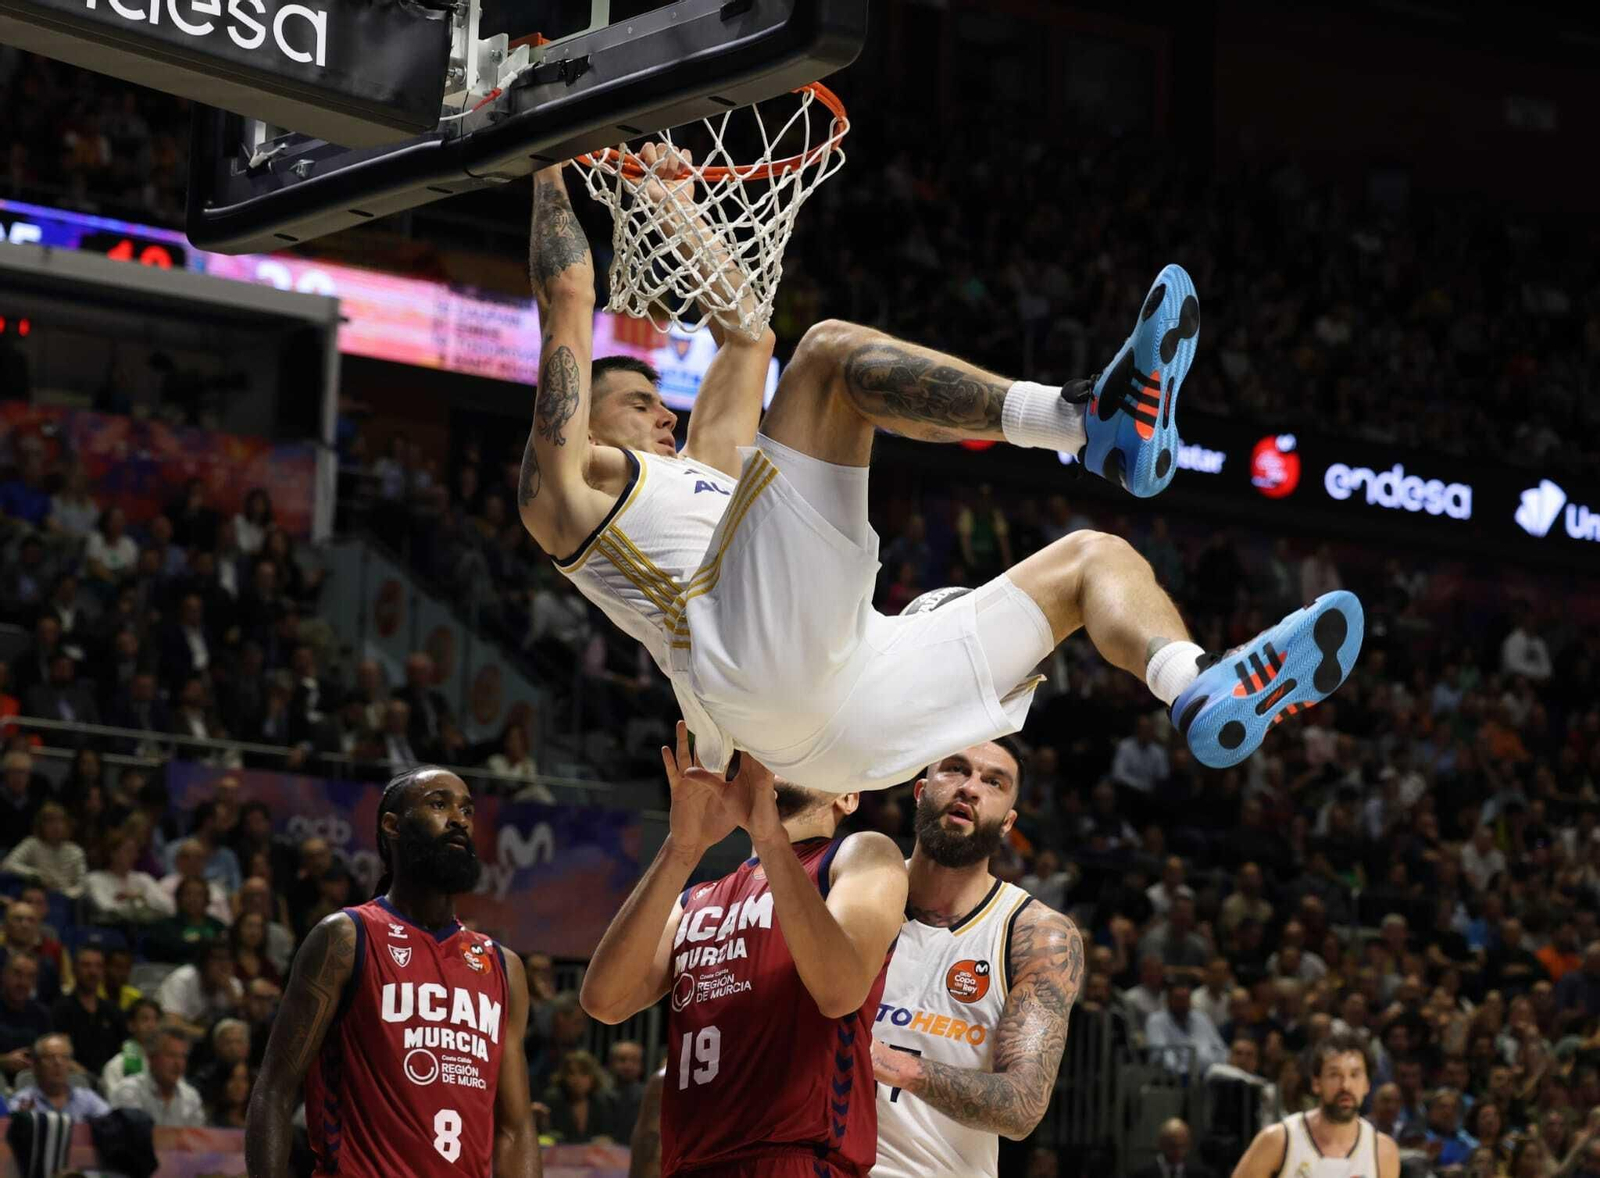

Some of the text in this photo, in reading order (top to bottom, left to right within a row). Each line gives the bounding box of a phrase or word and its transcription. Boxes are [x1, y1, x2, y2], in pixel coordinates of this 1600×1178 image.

[1324, 462, 1473, 521] endesa
[381, 982, 502, 1045] UCAM
[696, 980, 752, 1003] DE MURCIA
[404, 1027, 489, 1063] MURCIA
[679, 1025, 722, 1091] 19
[441, 1062, 479, 1077] REGIÓN
[442, 1073, 456, 1084] DE
[433, 1108, 462, 1164] 8
